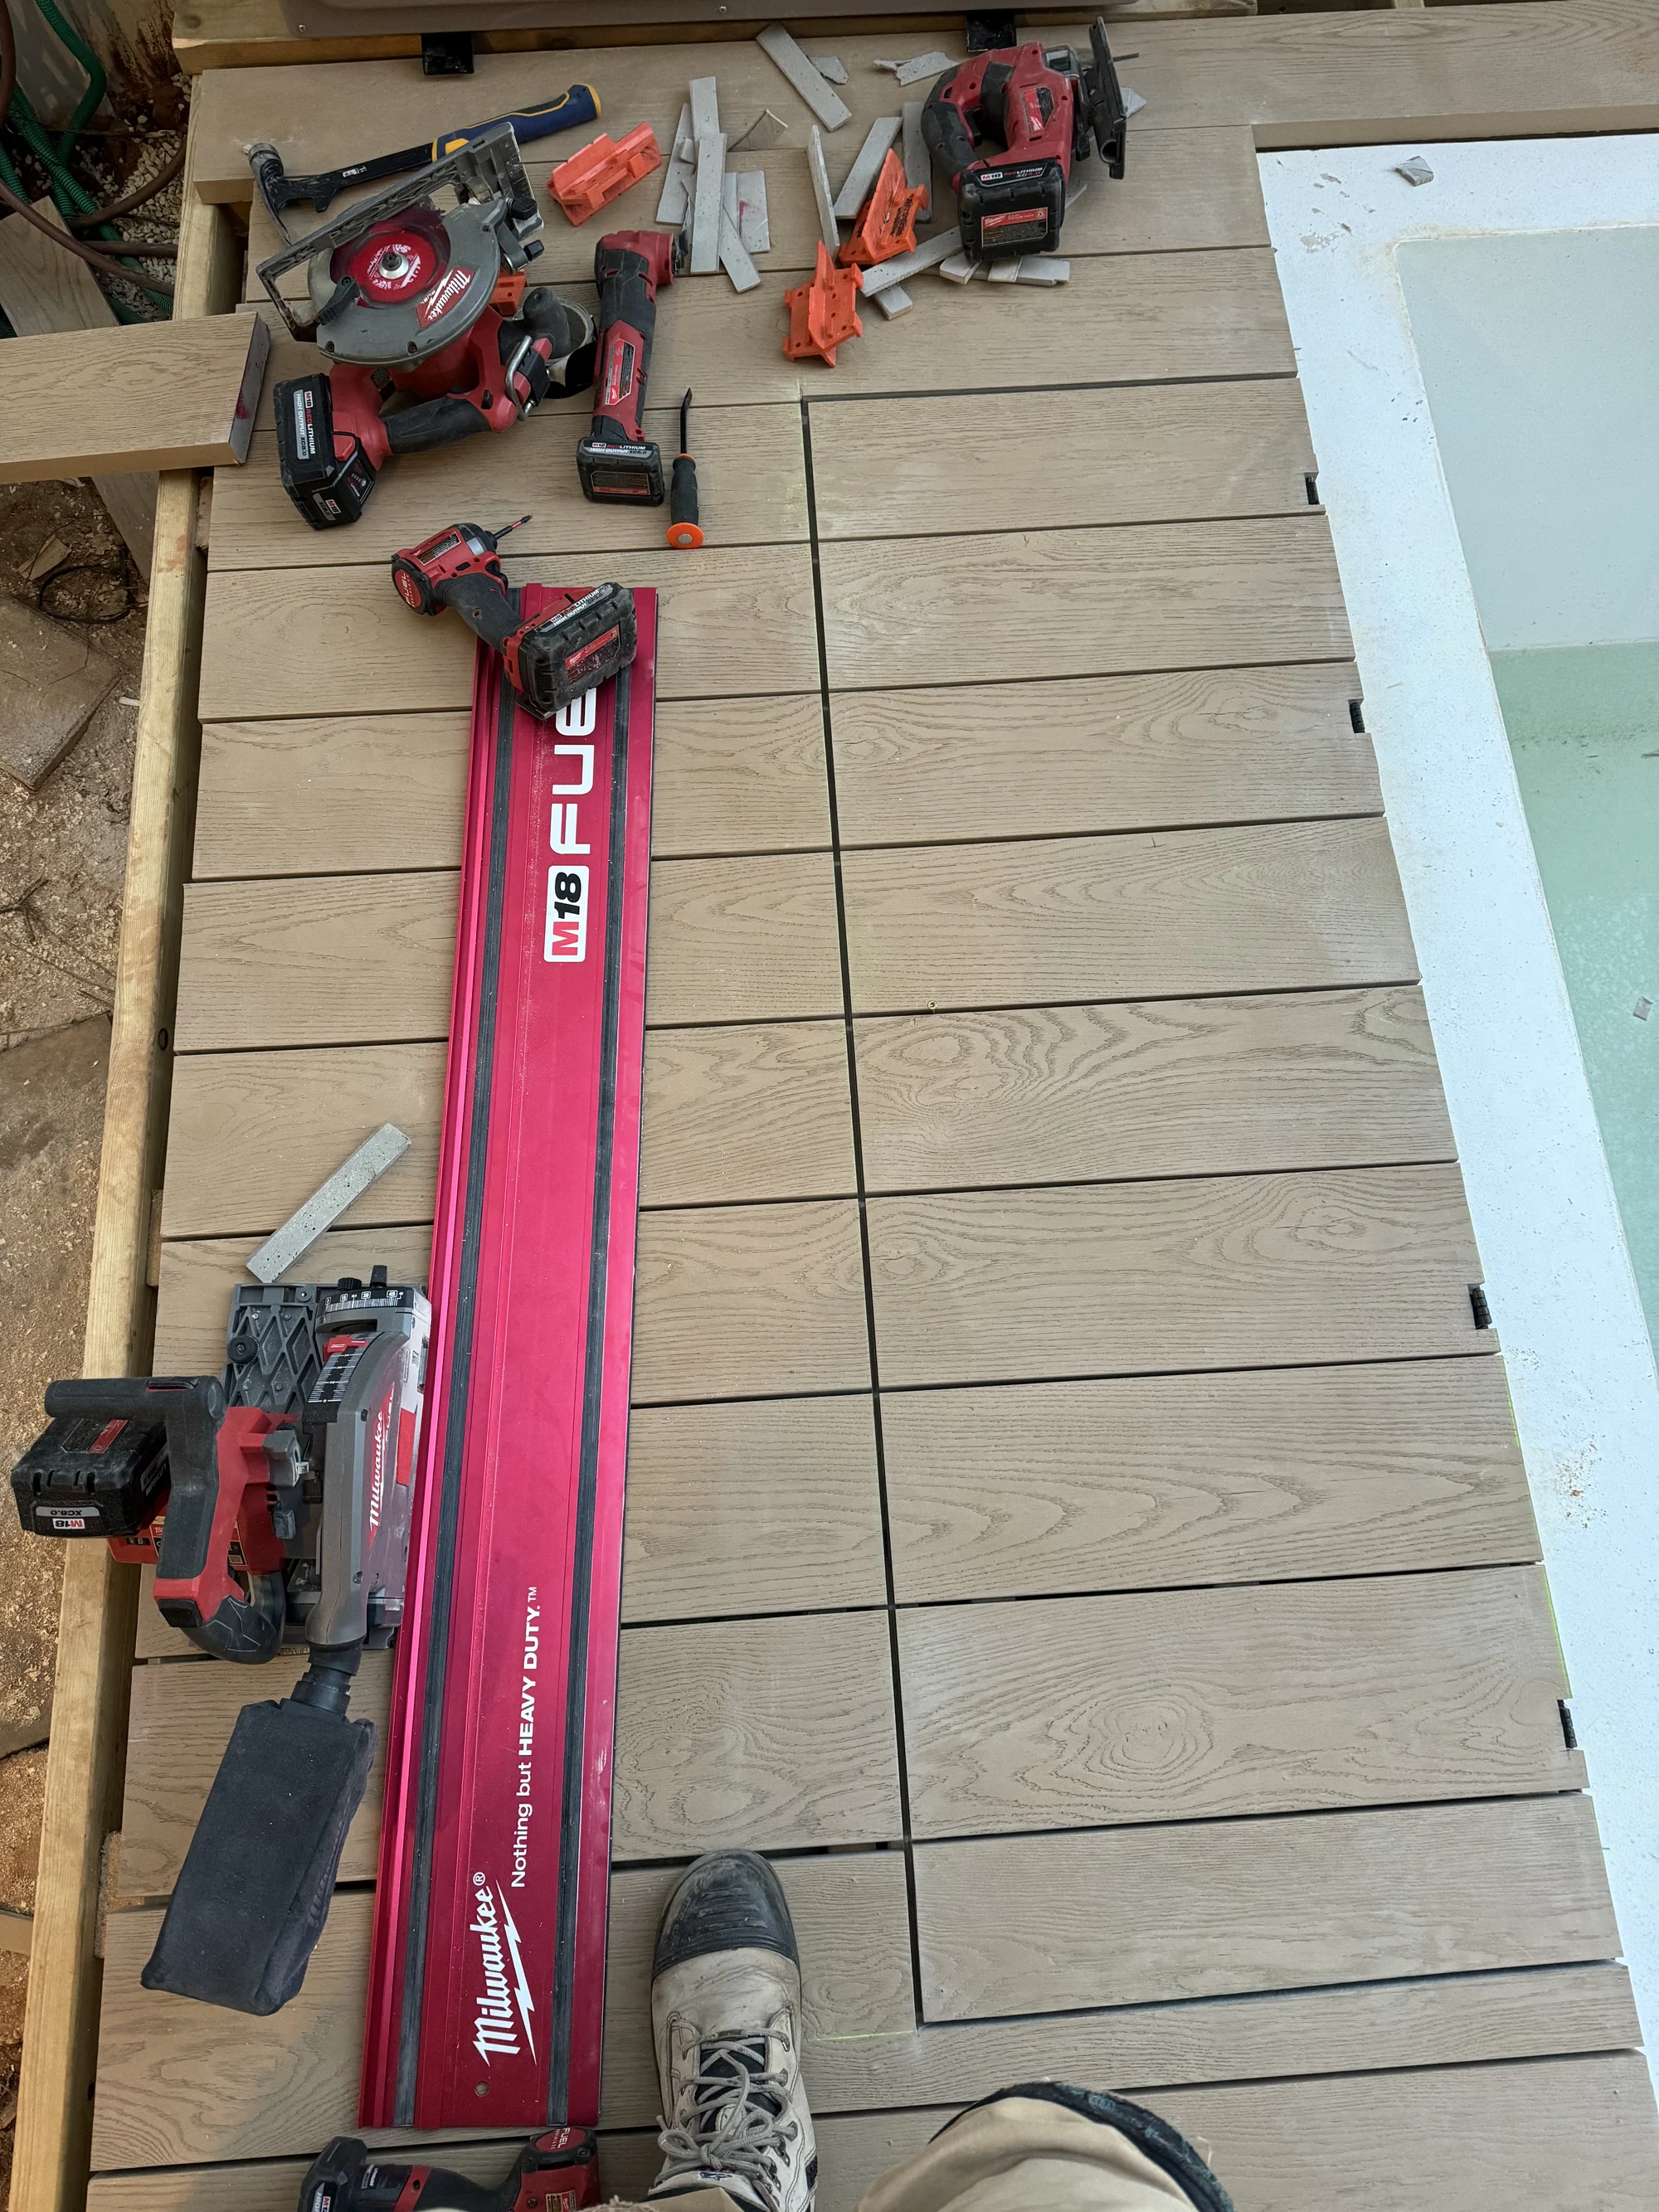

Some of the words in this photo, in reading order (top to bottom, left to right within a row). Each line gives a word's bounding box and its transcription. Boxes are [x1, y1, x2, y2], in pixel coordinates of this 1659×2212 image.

[304, 391, 313, 407] M18
[551, 872, 582, 956] M18
[369, 1410, 384, 1532] Milwaukee
[55, 1519, 84, 1529] M18
[518, 1675, 536, 1756] HEAVY
[516, 1762, 532, 1796] but
[511, 1803, 533, 1888] Nothing
